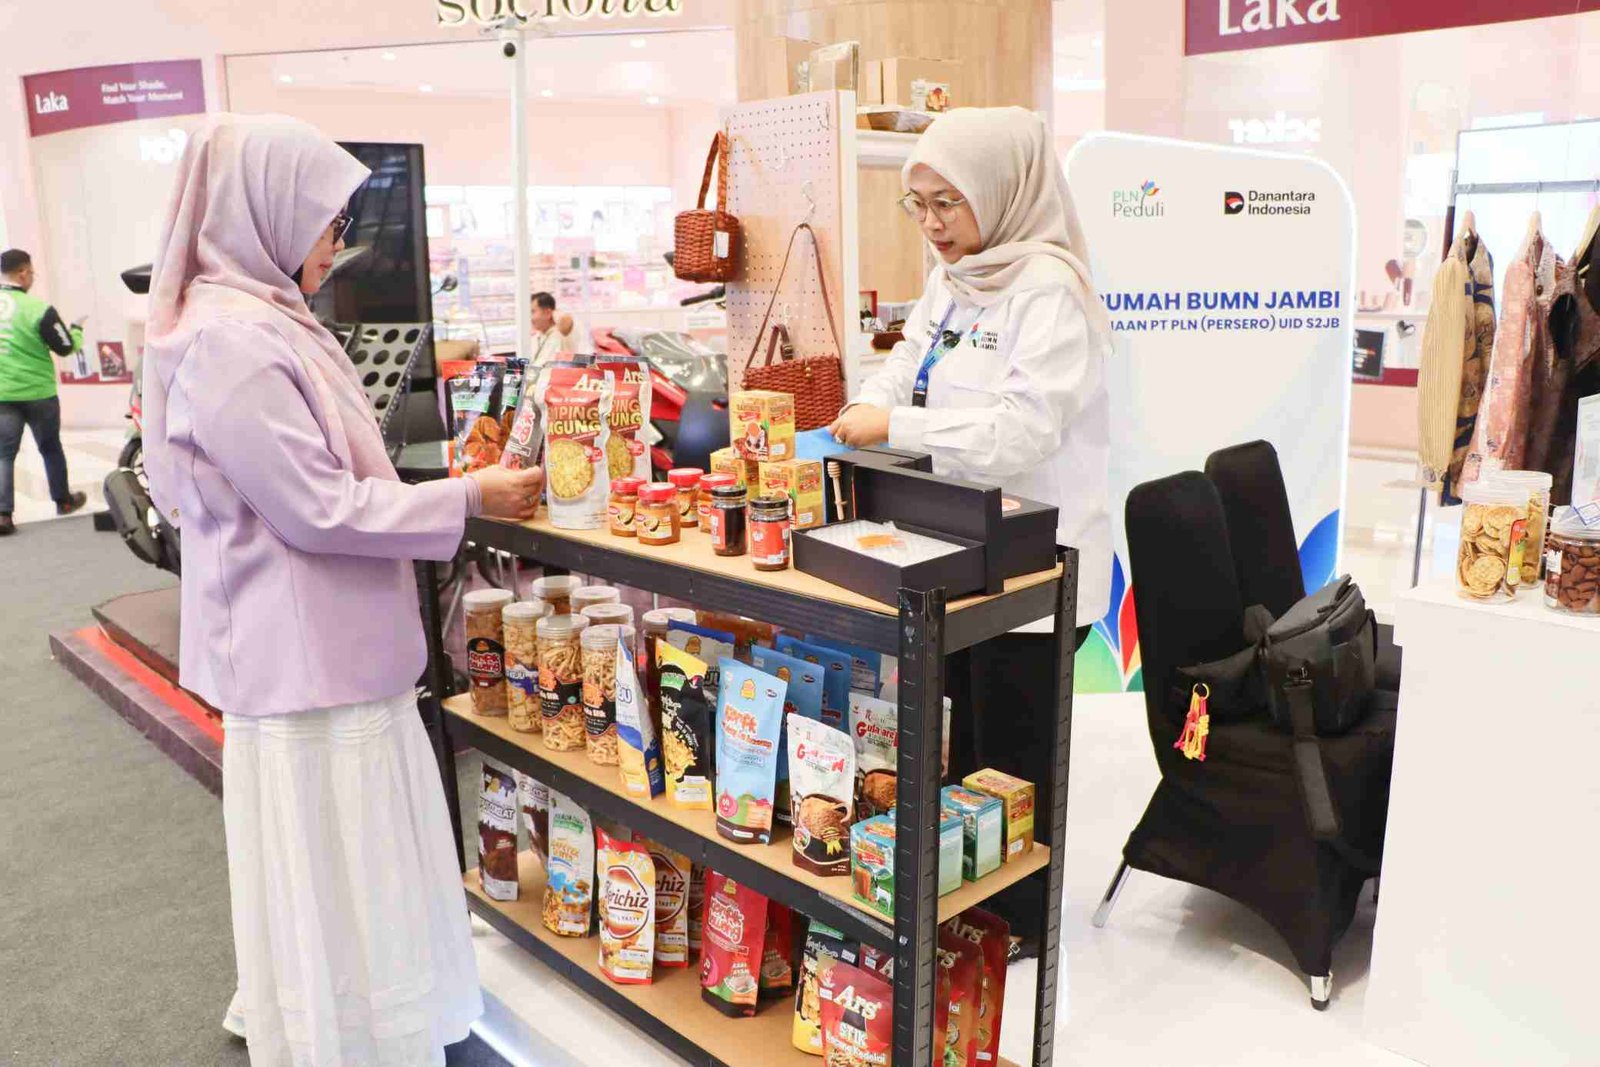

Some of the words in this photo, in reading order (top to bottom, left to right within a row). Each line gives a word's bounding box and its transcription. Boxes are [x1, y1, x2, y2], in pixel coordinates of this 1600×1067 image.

[119, 82, 137, 92] Your
[35, 91, 69, 114] Laka
[127, 93, 146, 103] Your
[1112, 189, 1139, 202] PLN
[1248, 190, 1315, 202] Danantara
[1112, 202, 1164, 218] Peduli
[1248, 204, 1311, 216] Indonesia
[1100, 291, 1181, 311] UMAH
[1186, 291, 1259, 310] BUMN
[1264, 290, 1341, 310] JAMBI
[1111, 320, 1147, 331] AAN
[1150, 320, 1168, 331] PT
[1171, 319, 1198, 331] PLN
[1201, 314, 1275, 333] (PERSERO)
[1279, 318, 1303, 330] UID
[1306, 317, 1340, 329] S2JB
[947, 915, 984, 945] Ars
[936, 947, 956, 969] rs
[833, 985, 880, 1020] Ars
